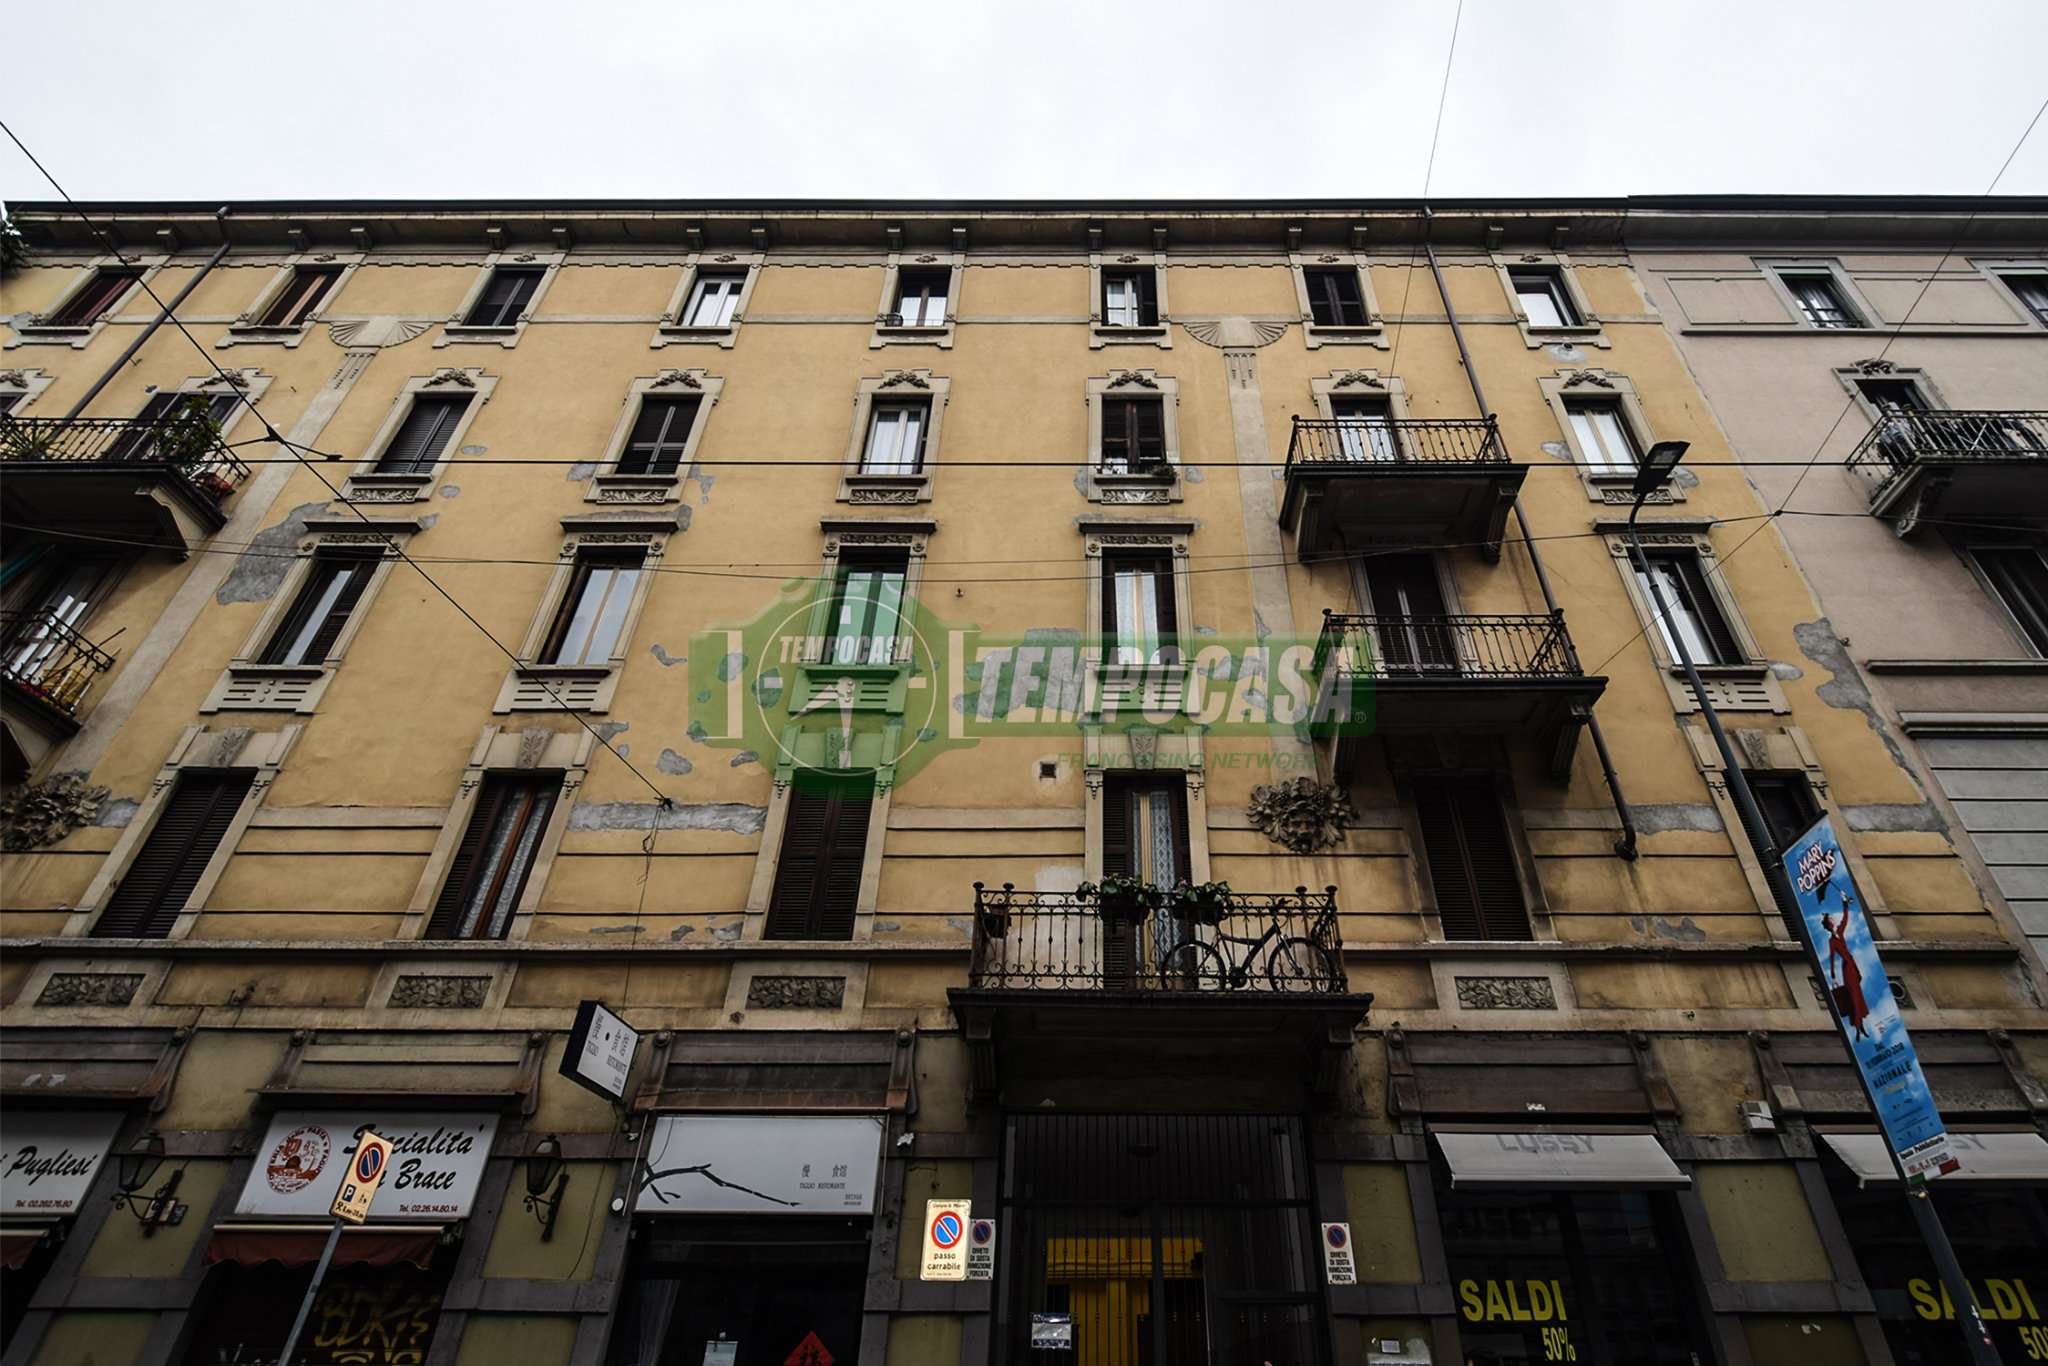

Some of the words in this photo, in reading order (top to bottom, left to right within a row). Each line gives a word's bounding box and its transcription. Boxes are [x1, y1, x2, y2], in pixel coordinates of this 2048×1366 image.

[1797, 849, 1836, 893] POPPINS
[1798, 840, 1823, 874] MARY
[1873, 1060, 1912, 1088] NAZIONALE
[4, 1145, 98, 1186] Pugliesi
[394, 1158, 456, 1190] Brace
[927, 1262, 961, 1270] carrabile
[934, 1252, 956, 1260] passo
[1460, 1279, 1568, 1321] SALDI
[1541, 1326, 1577, 1361] 50%
